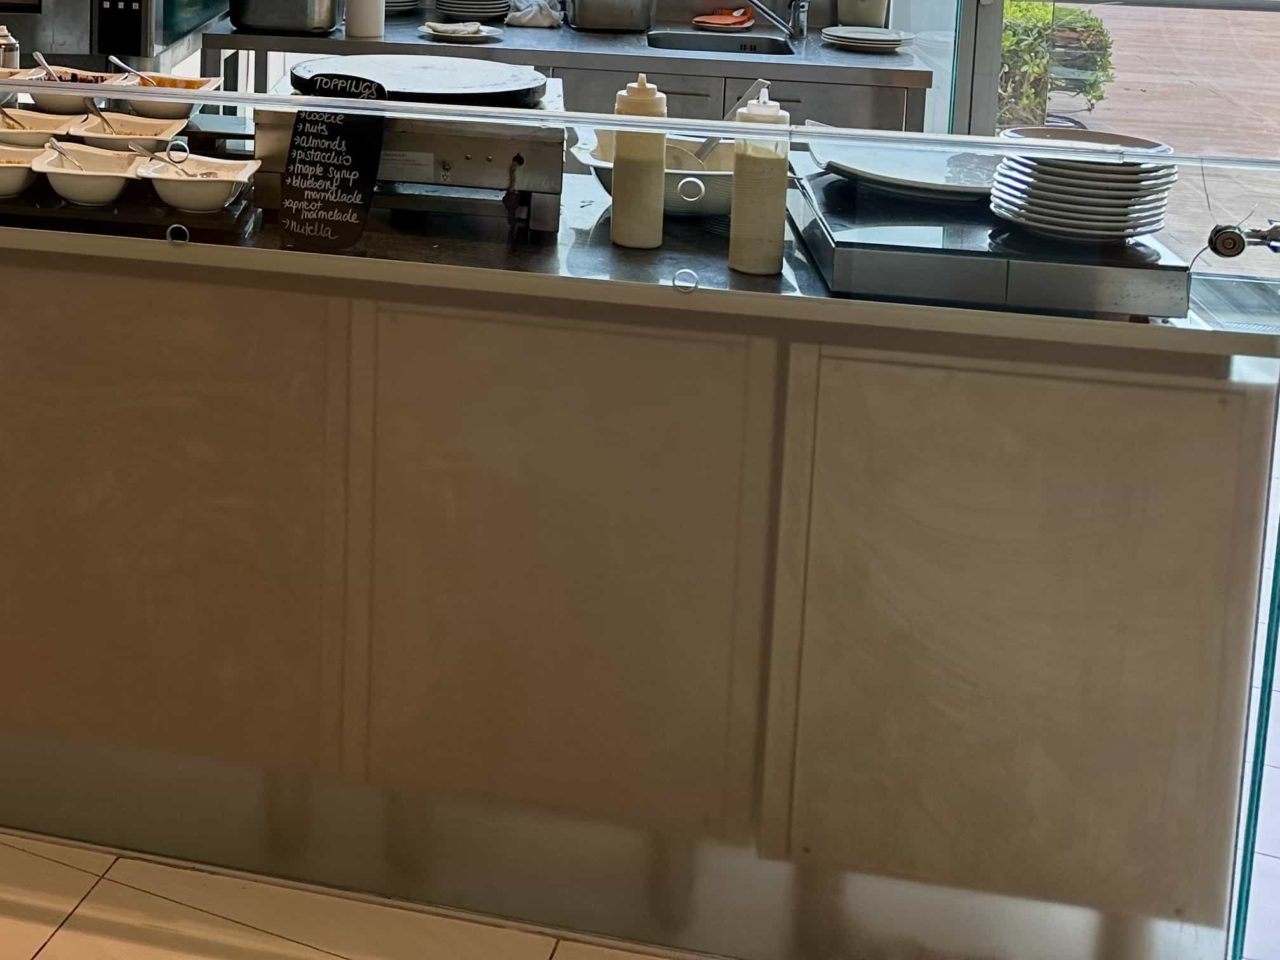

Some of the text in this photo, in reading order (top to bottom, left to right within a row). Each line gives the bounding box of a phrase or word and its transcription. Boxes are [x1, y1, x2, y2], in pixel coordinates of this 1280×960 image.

[314, 76, 378, 99] TOPPINGS
[304, 122, 328, 135] nuts
[300, 135, 346, 152] almonds
[294, 163, 359, 187] maple syrup
[286, 199, 323, 214] apricot
[301, 208, 360, 223] marmelade
